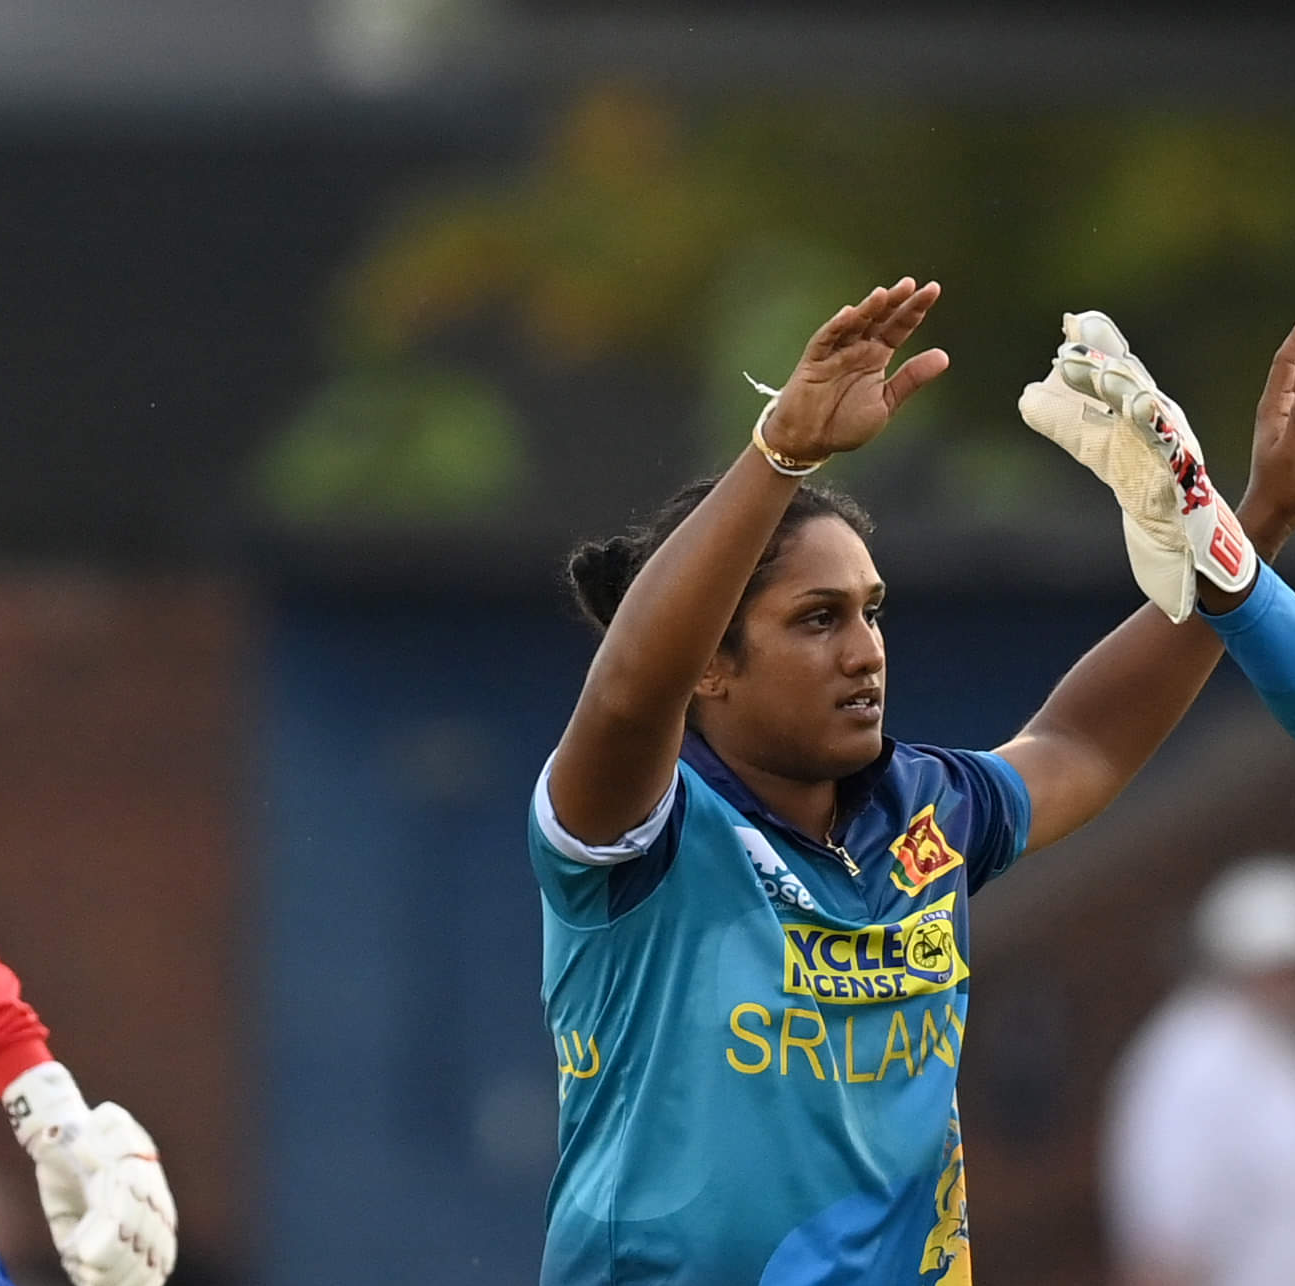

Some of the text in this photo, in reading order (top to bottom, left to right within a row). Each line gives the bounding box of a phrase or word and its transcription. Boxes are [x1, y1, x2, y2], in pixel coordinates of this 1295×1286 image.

[787, 923, 905, 972] YCLE
[792, 961, 907, 998] ICENSE
[844, 1003, 965, 1083] LAN
